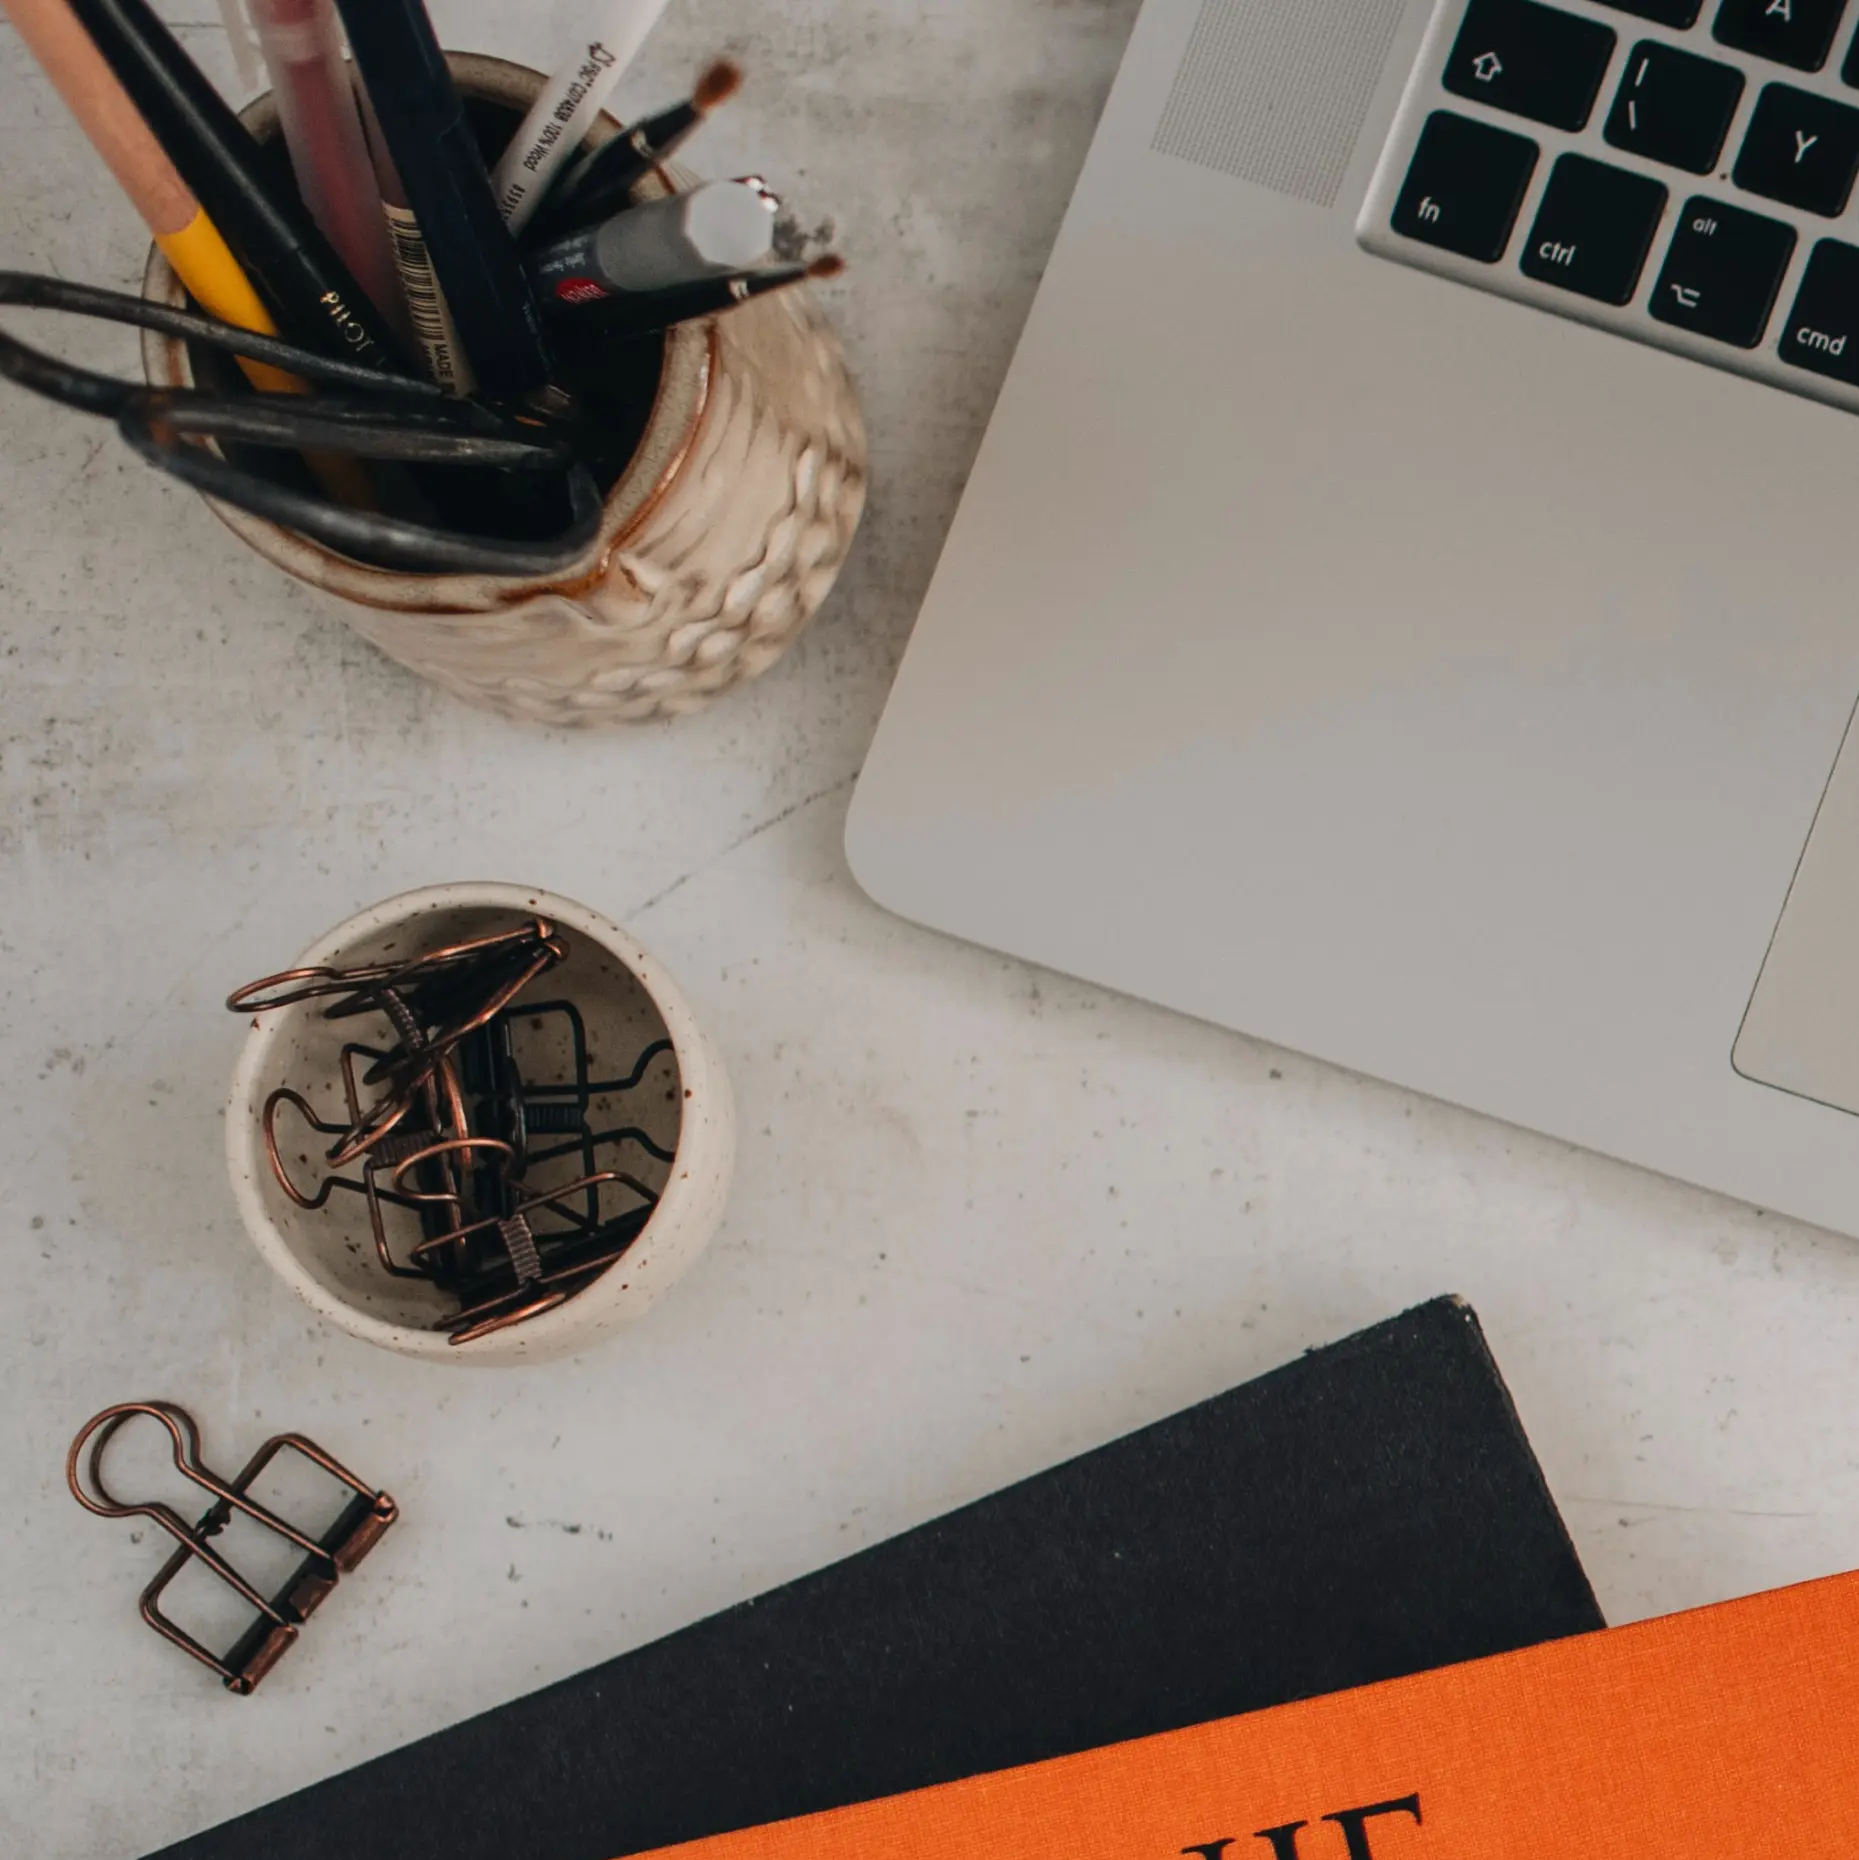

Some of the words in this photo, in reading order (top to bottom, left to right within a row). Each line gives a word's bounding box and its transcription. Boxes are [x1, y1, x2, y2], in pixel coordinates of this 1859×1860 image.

[1765, 0, 1791, 21] A
[523, 142, 547, 173] Wood
[1794, 130, 1818, 163] Y
[1418, 196, 1440, 222] fn
[1692, 218, 1717, 235] alt
[1539, 241, 1576, 266] ctrl
[1795, 322, 1847, 357] cmd
